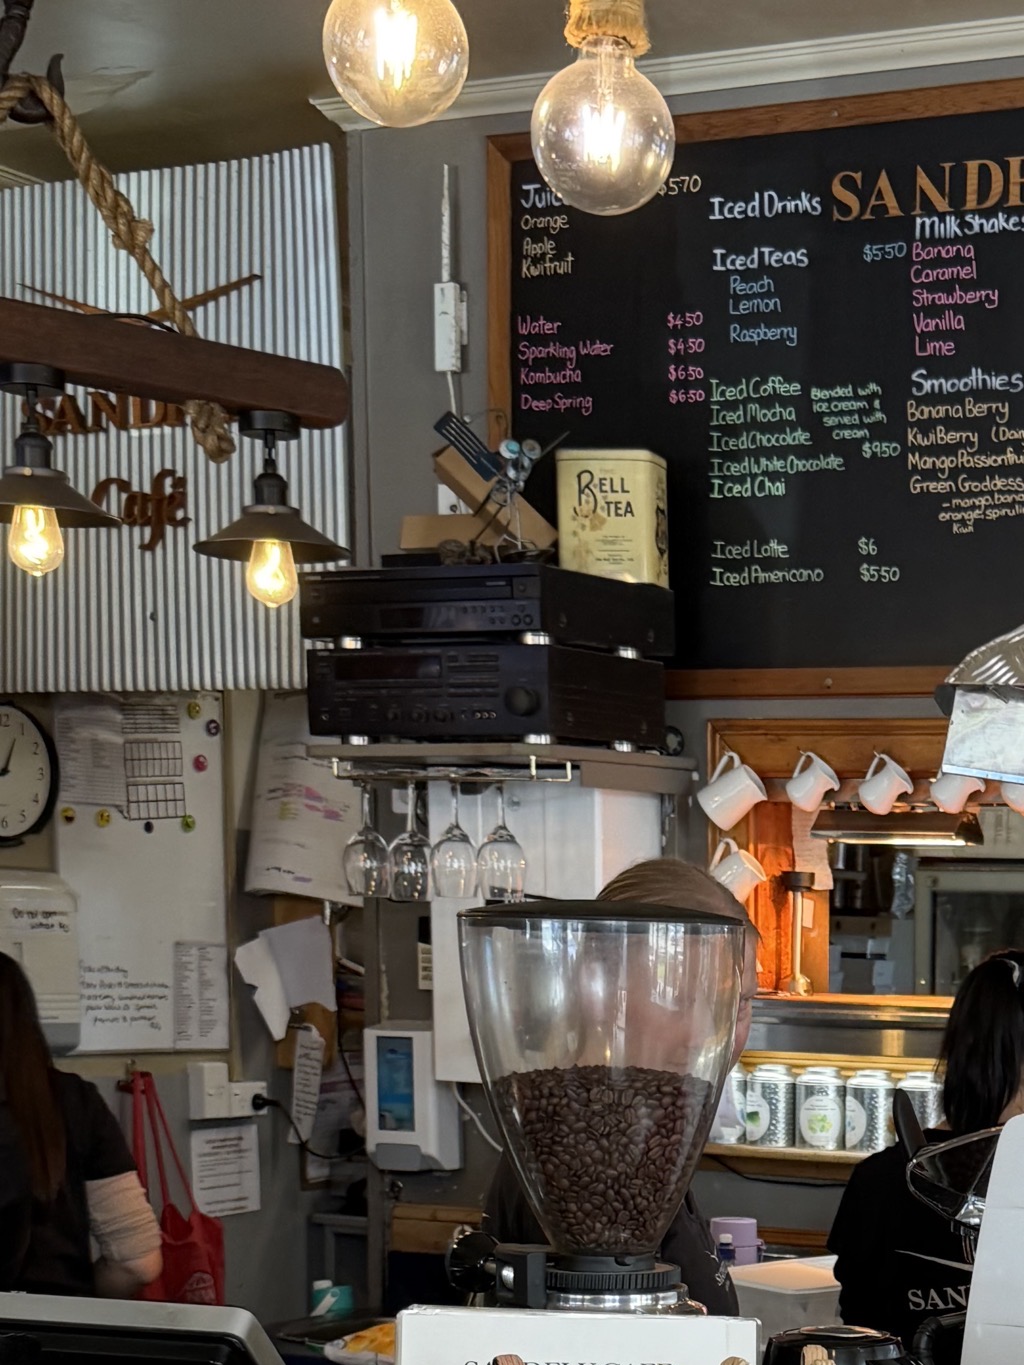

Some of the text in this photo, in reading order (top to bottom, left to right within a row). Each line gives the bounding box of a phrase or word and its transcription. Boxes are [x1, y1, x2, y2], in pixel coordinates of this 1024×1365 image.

[709, 191, 822, 220] Iced Drinks
[521, 215, 569, 234] Orange
[915, 215, 963, 240] Milk
[523, 236, 557, 257] Apple
[912, 242, 975, 262] Banana
[713, 247, 809, 270] Iced Teas
[910, 260, 977, 284] Caramel
[730, 275, 774, 295] Peach
[912, 284, 998, 309] Strawberry
[729, 298, 782, 315] Lemon
[518, 316, 561, 335] Water
[913, 310, 965, 334] Vanilla
[730, 323, 797, 346] Raspberry
[915, 336, 956, 356] Lime
[518, 340, 614, 368] Sparkling Water
[520, 368, 582, 385] Kombucha
[911, 367, 1024, 396] Smoothies
[709, 376, 801, 401] Iced Coffee
[554, 393, 592, 415] Spring
[709, 403, 797, 425] Iced Mocha
[907, 398, 1009, 424] Banana Berry
[709, 427, 813, 451] Iced Chocolate
[936, 425, 978, 452] Berry
[709, 453, 846, 476] Iced Chocolate
[908, 451, 956, 478] Mango
[709, 476, 786, 498] Iced Chai
[909, 474, 1024, 494] Green Goddess
[605, 500, 635, 518] TEA
[711, 536, 878, 559] Iced Latte $6
[709, 565, 824, 586] Iced Americano
